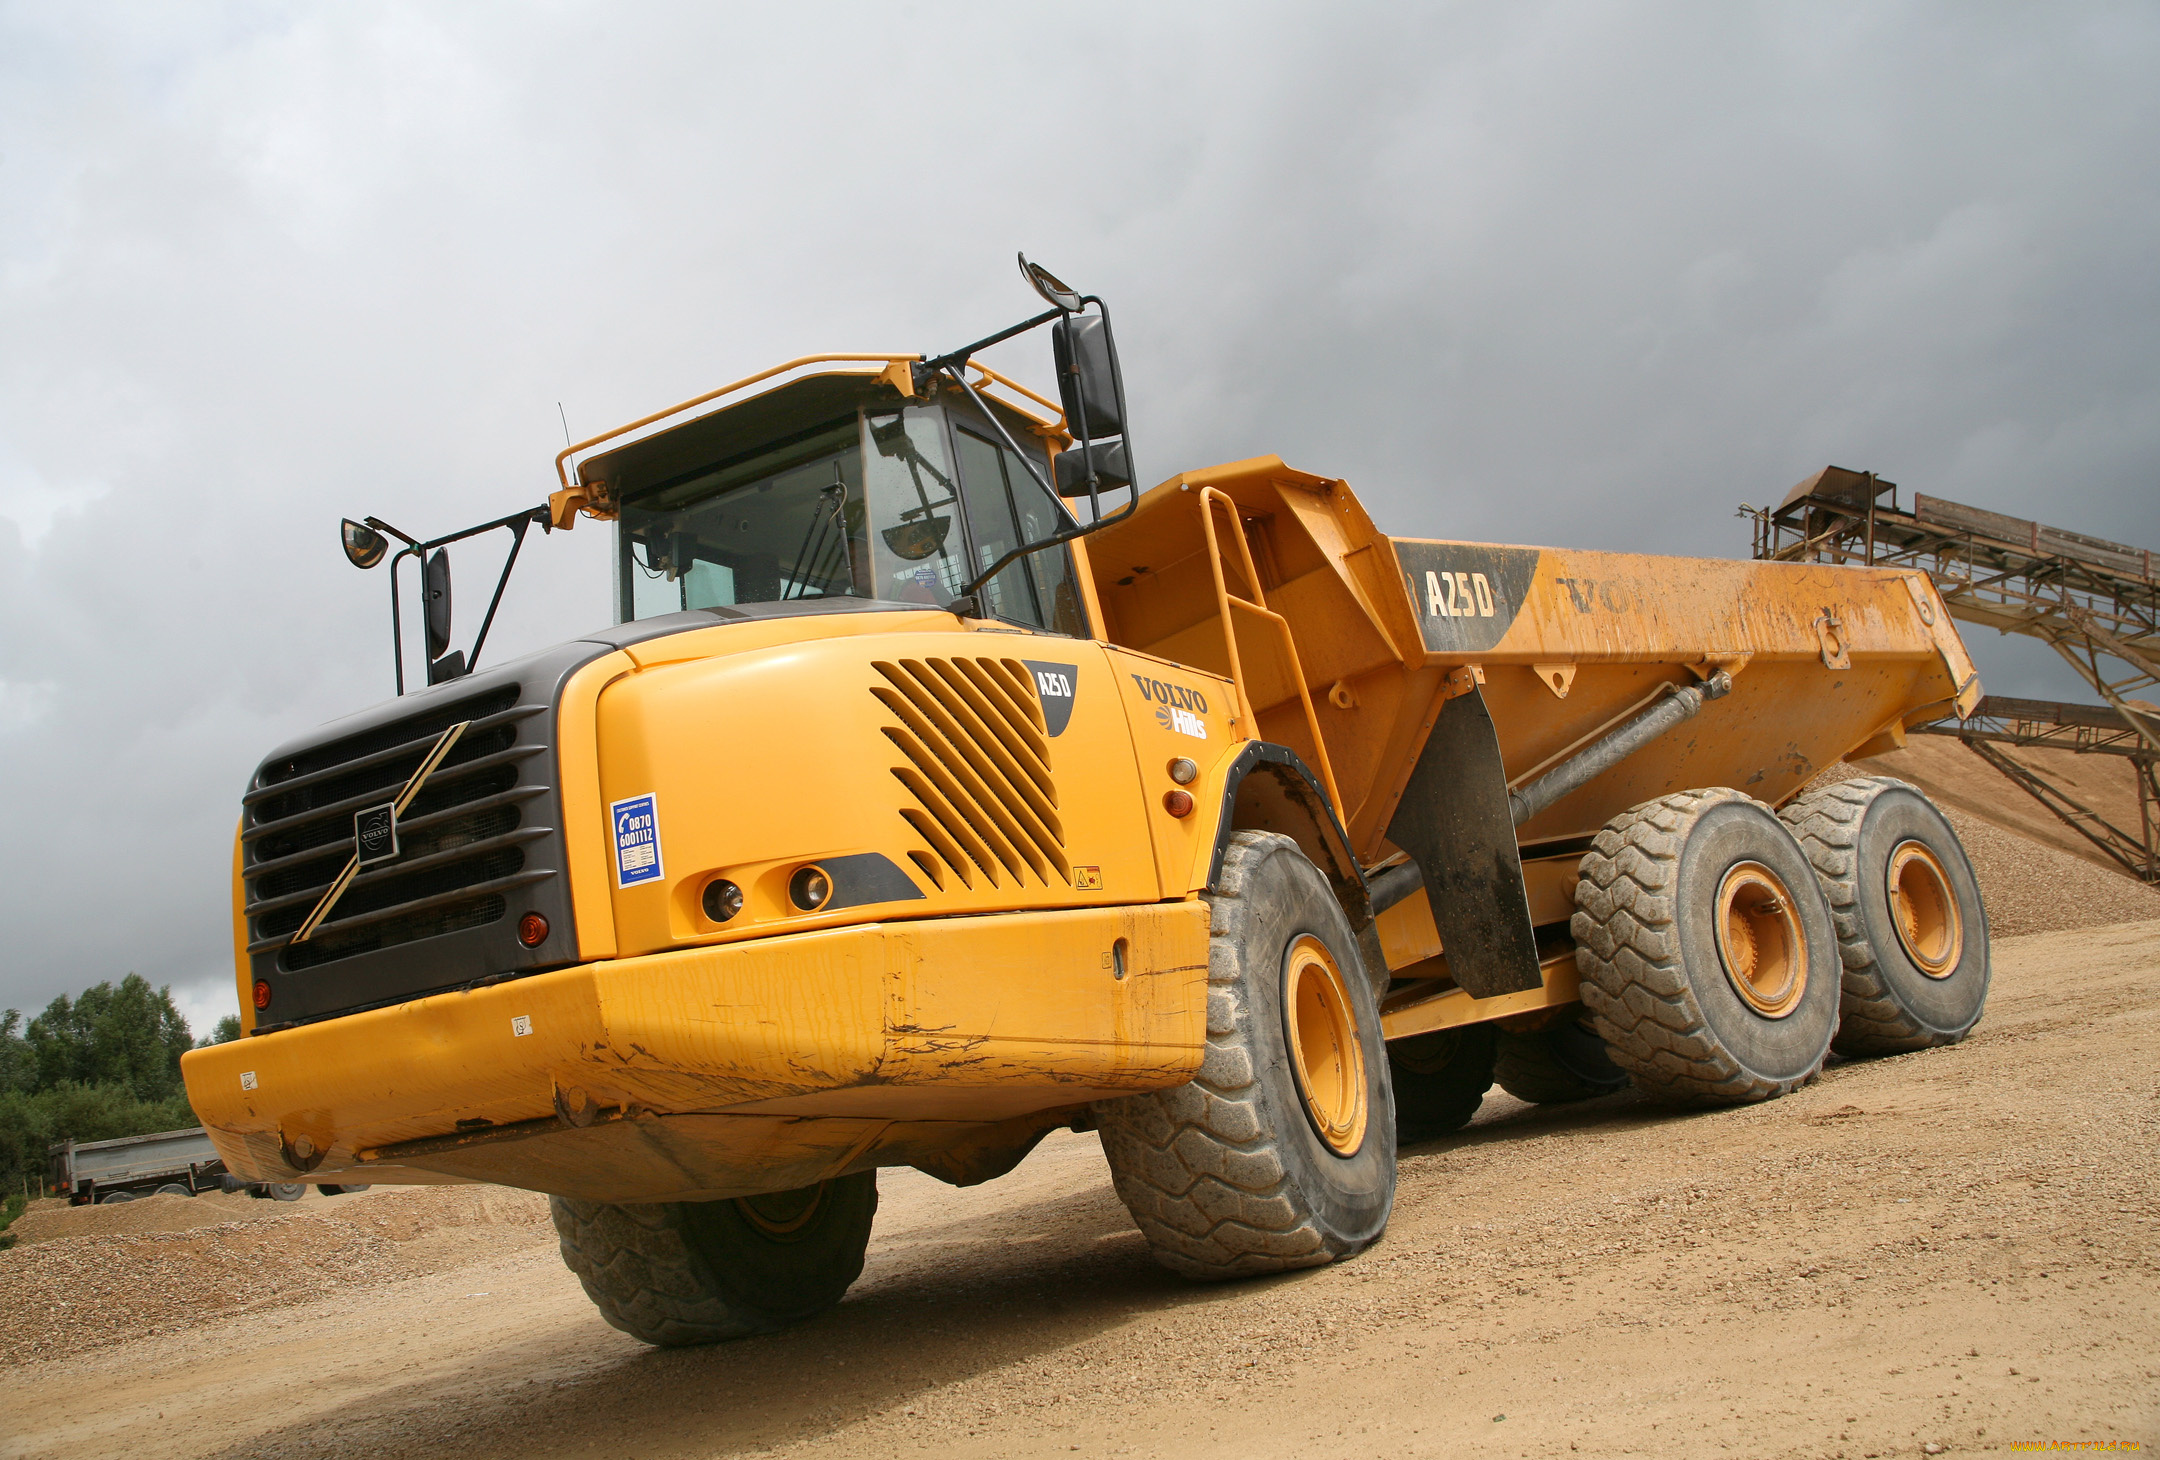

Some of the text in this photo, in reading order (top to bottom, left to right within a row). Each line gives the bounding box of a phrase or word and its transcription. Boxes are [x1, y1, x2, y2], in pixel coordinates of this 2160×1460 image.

[1425, 571, 1495, 618] A25D
[1037, 671, 1072, 698] A25D
[1131, 673, 1209, 715] VOLVO
[1170, 707, 1207, 740] Hills
[362, 828, 389, 839] VOLVO
[629, 814, 651, 831] 0870
[620, 828, 653, 847] 6001112
